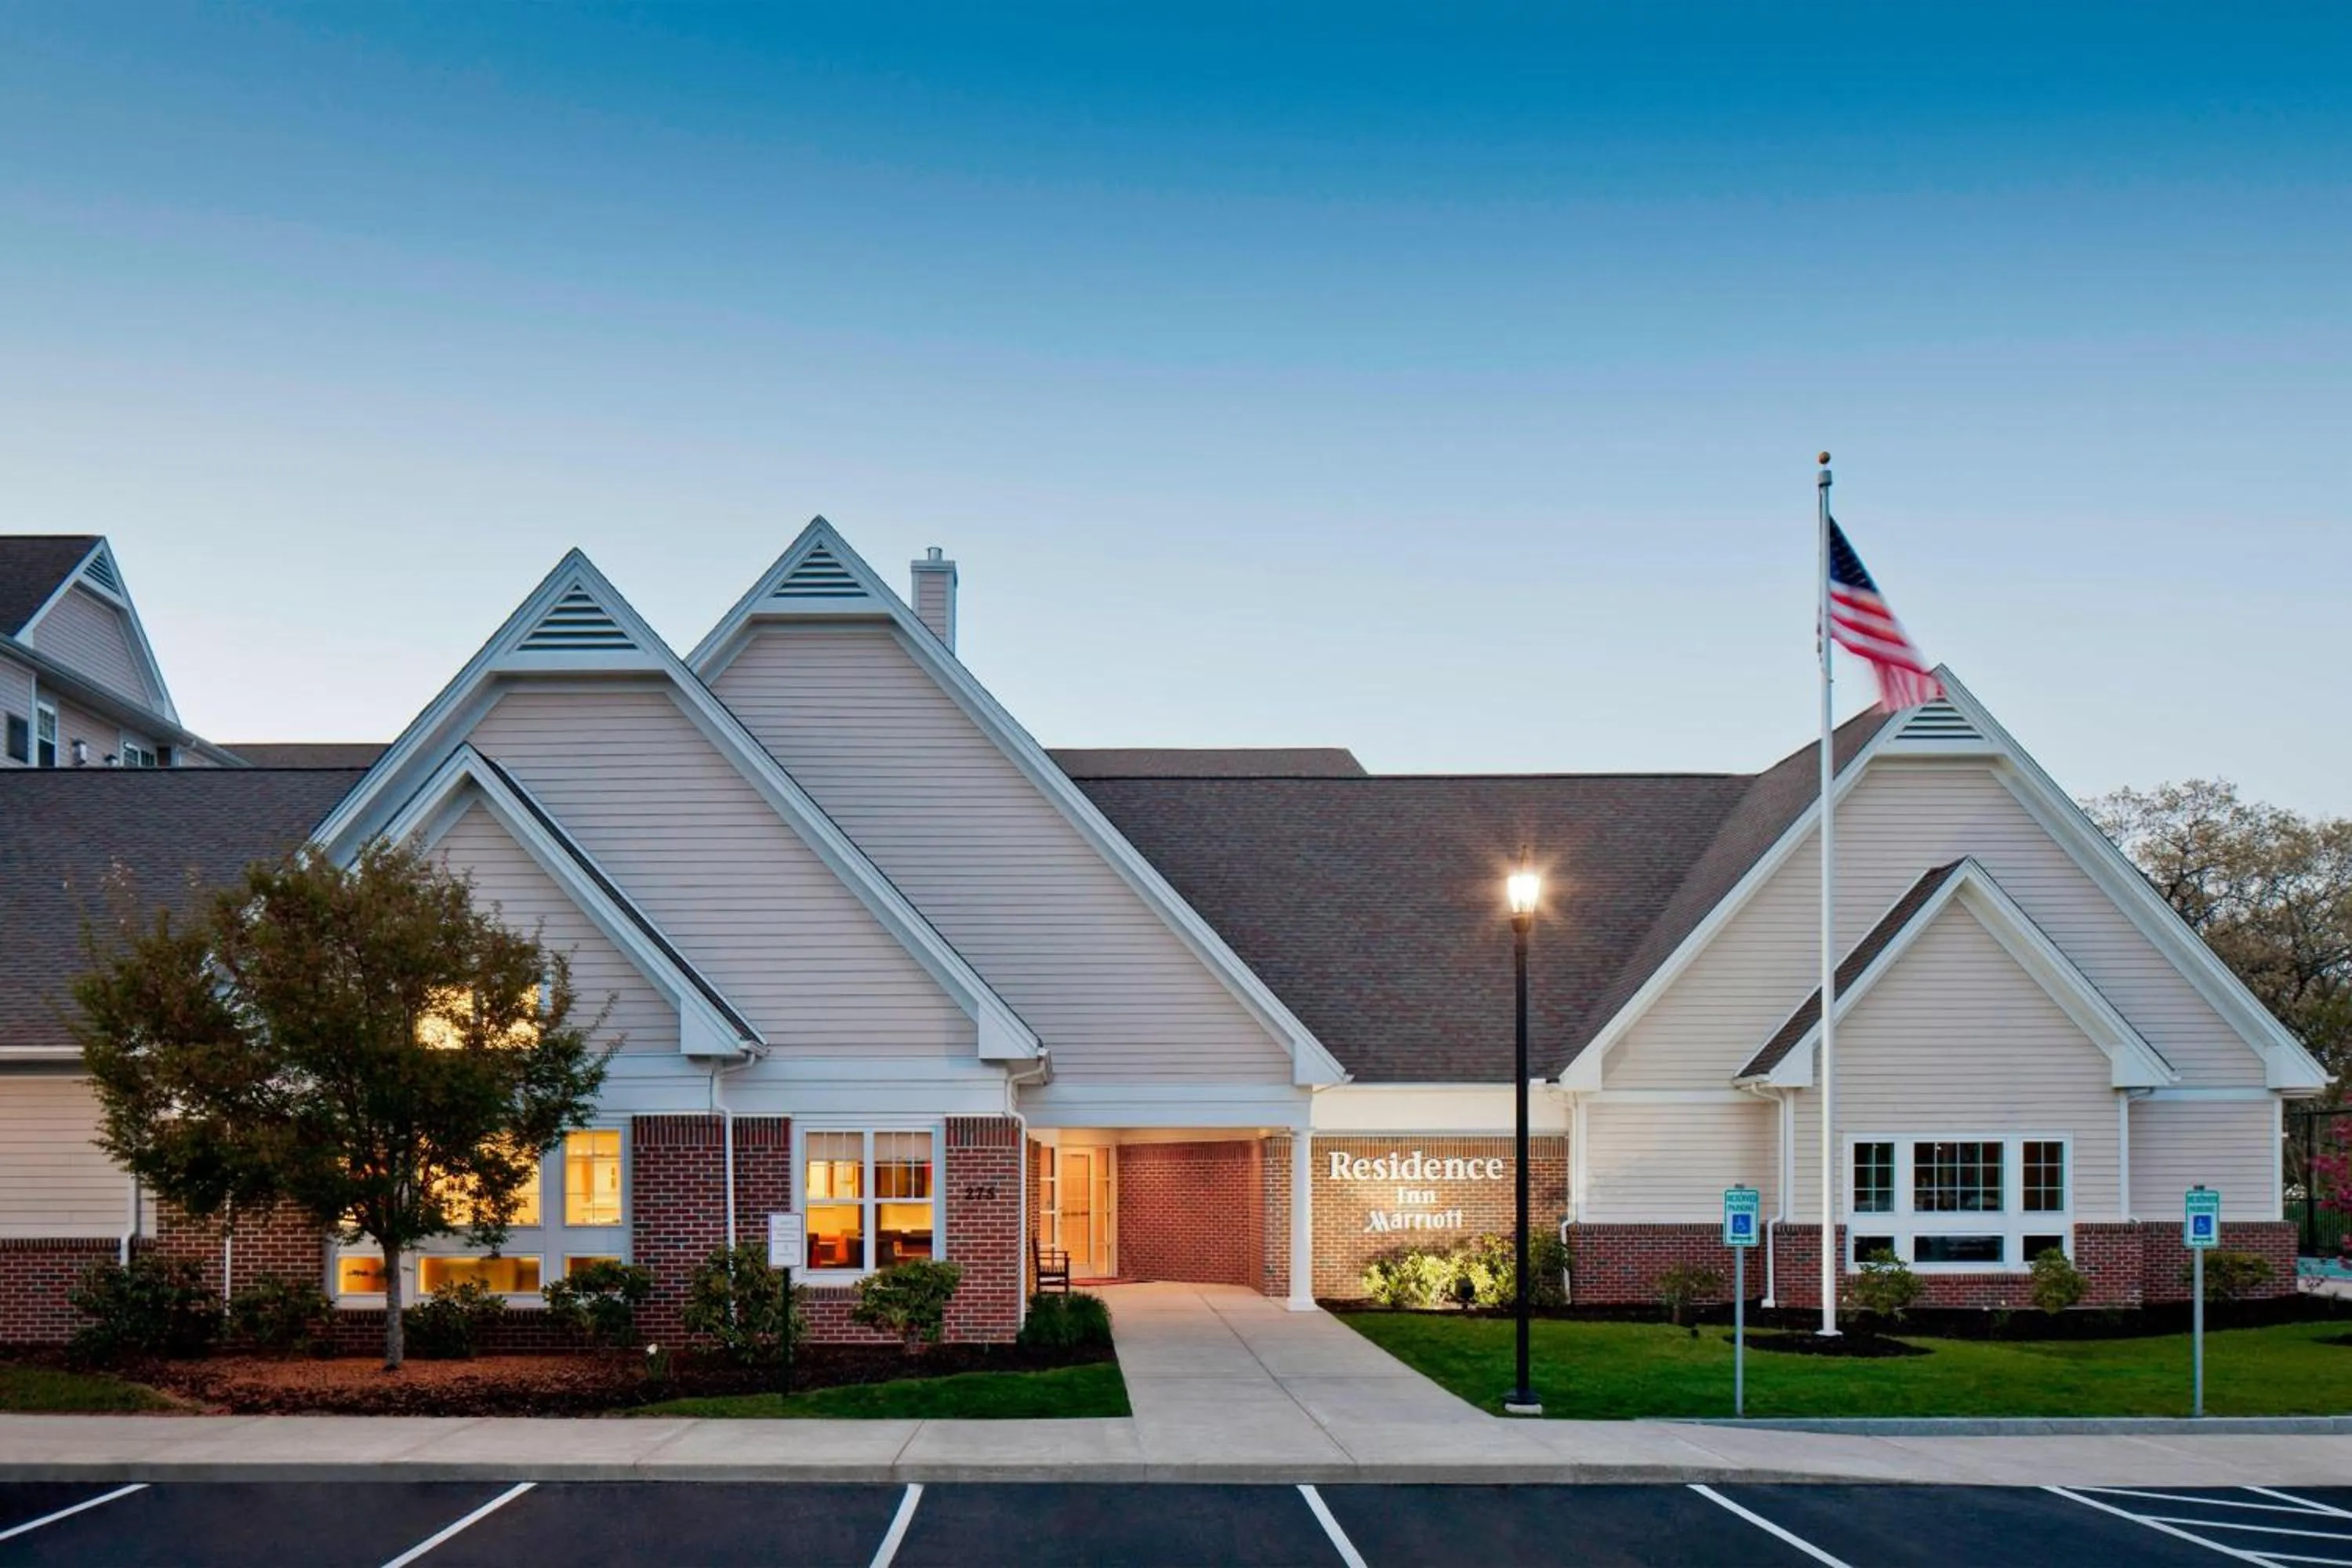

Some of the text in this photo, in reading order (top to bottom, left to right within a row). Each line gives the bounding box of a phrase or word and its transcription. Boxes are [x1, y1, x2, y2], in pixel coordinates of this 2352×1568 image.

[1328, 1150, 1504, 1180] Residence
[965, 1186, 996, 1200] 275
[1398, 1186, 1436, 1204] Inn
[1363, 1210, 1464, 1232] Marriott
